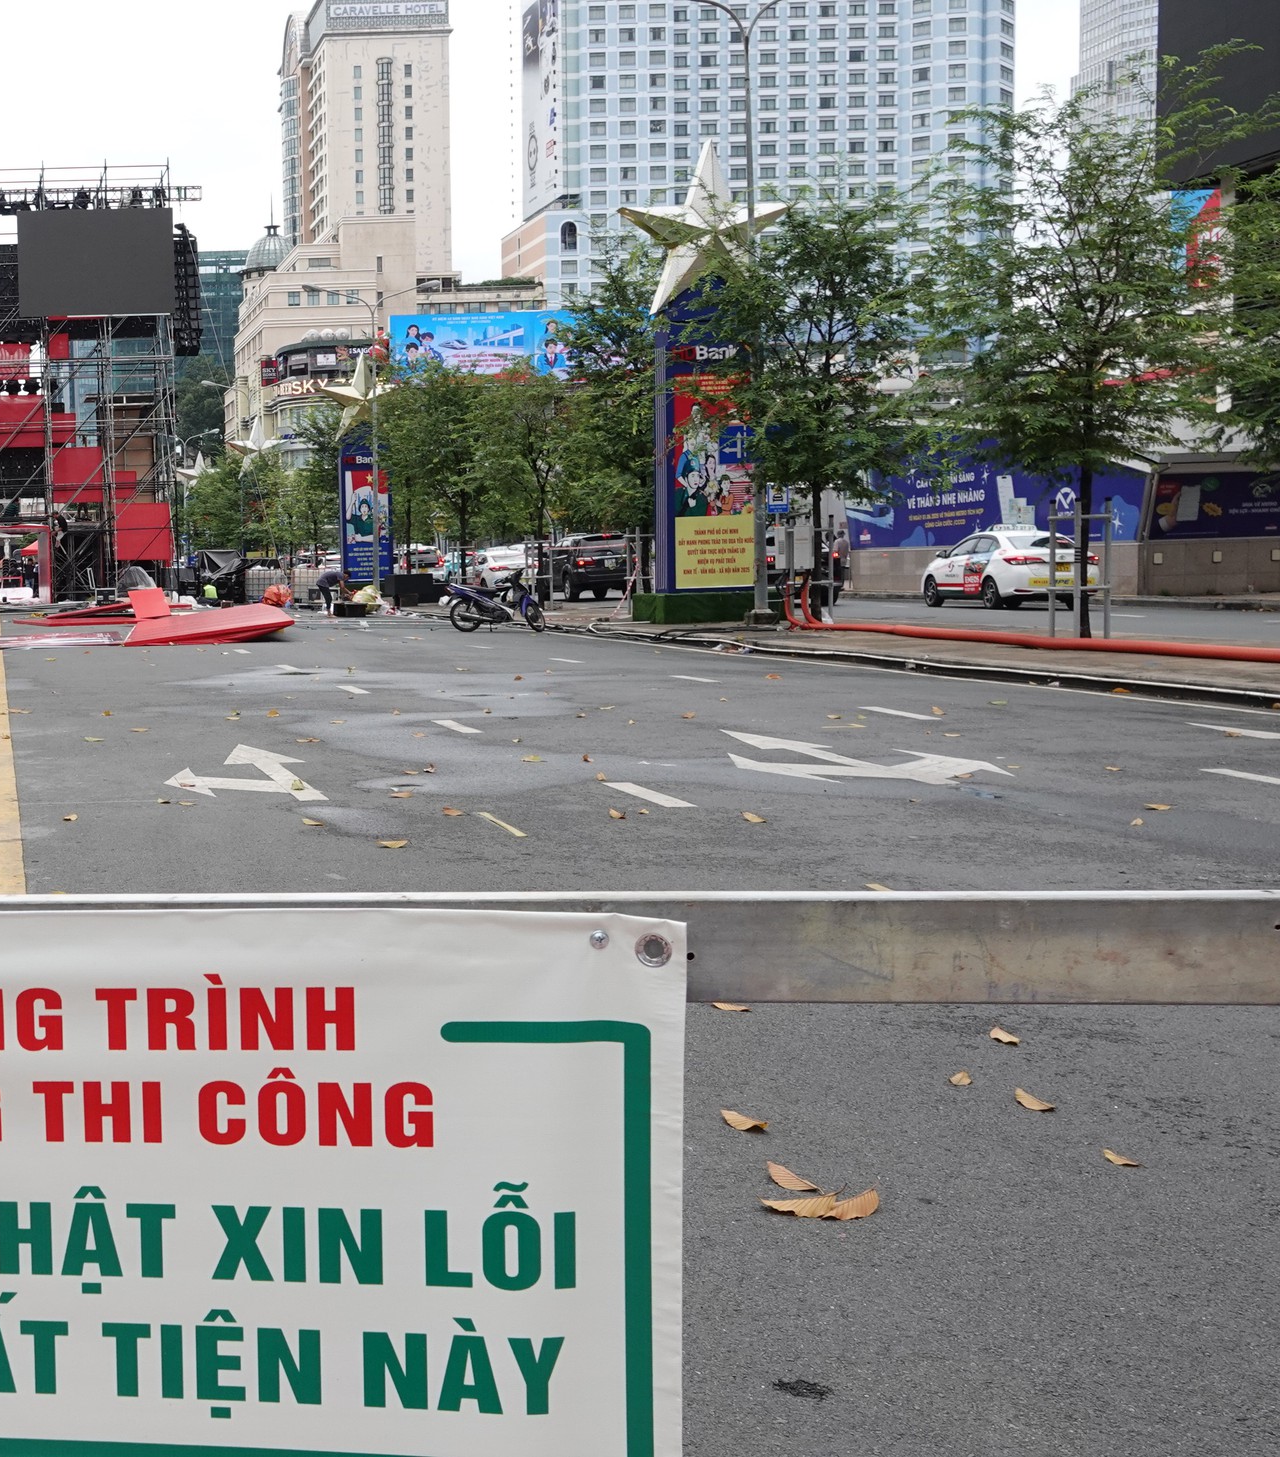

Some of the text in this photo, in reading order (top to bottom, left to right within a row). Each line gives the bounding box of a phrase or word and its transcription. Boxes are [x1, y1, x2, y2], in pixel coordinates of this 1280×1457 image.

[334, 4, 442, 16] CARAVELLE HOTEL
[292, 379, 328, 395] SKY
[342, 456, 374, 464] HDBan
[959, 472, 975, 483] SÀNG
[907, 496, 916, 509] VÉ
[942, 494, 956, 507] NHẸ
[958, 488, 985, 503] NHÀNG
[95, 973, 356, 1052] TRÌNH
[32, 1080, 163, 1144] THI
[197, 1067, 434, 1149] CÔNG
[212, 1204, 383, 1285] XIN
[424, 1181, 576, 1291] LỖI
[101, 1309, 322, 1419] TIỆN
[362, 1317, 564, 1415] NÀY
